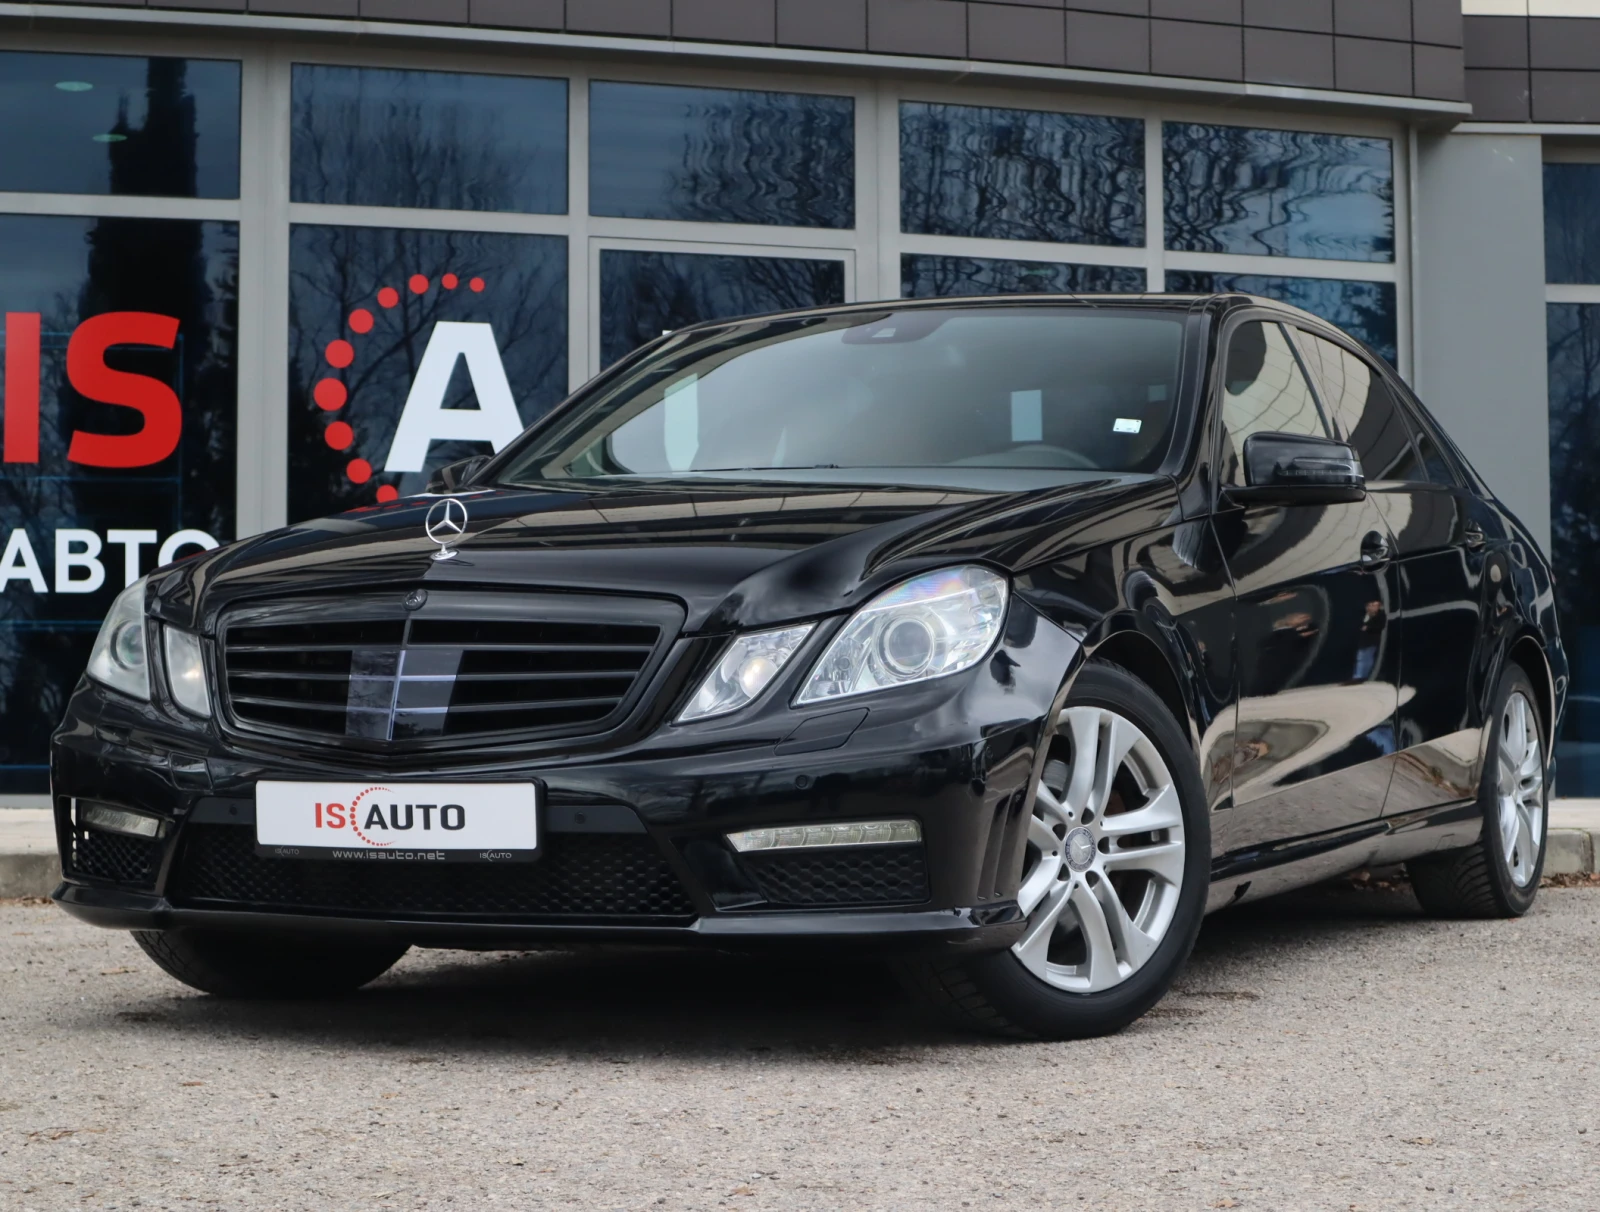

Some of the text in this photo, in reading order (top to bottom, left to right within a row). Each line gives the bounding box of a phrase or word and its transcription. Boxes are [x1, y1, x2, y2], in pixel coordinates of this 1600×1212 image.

[3, 311, 182, 468] IS
[315, 803, 466, 830] IS AUTO
[332, 850, 446, 860] www.isauto.net
